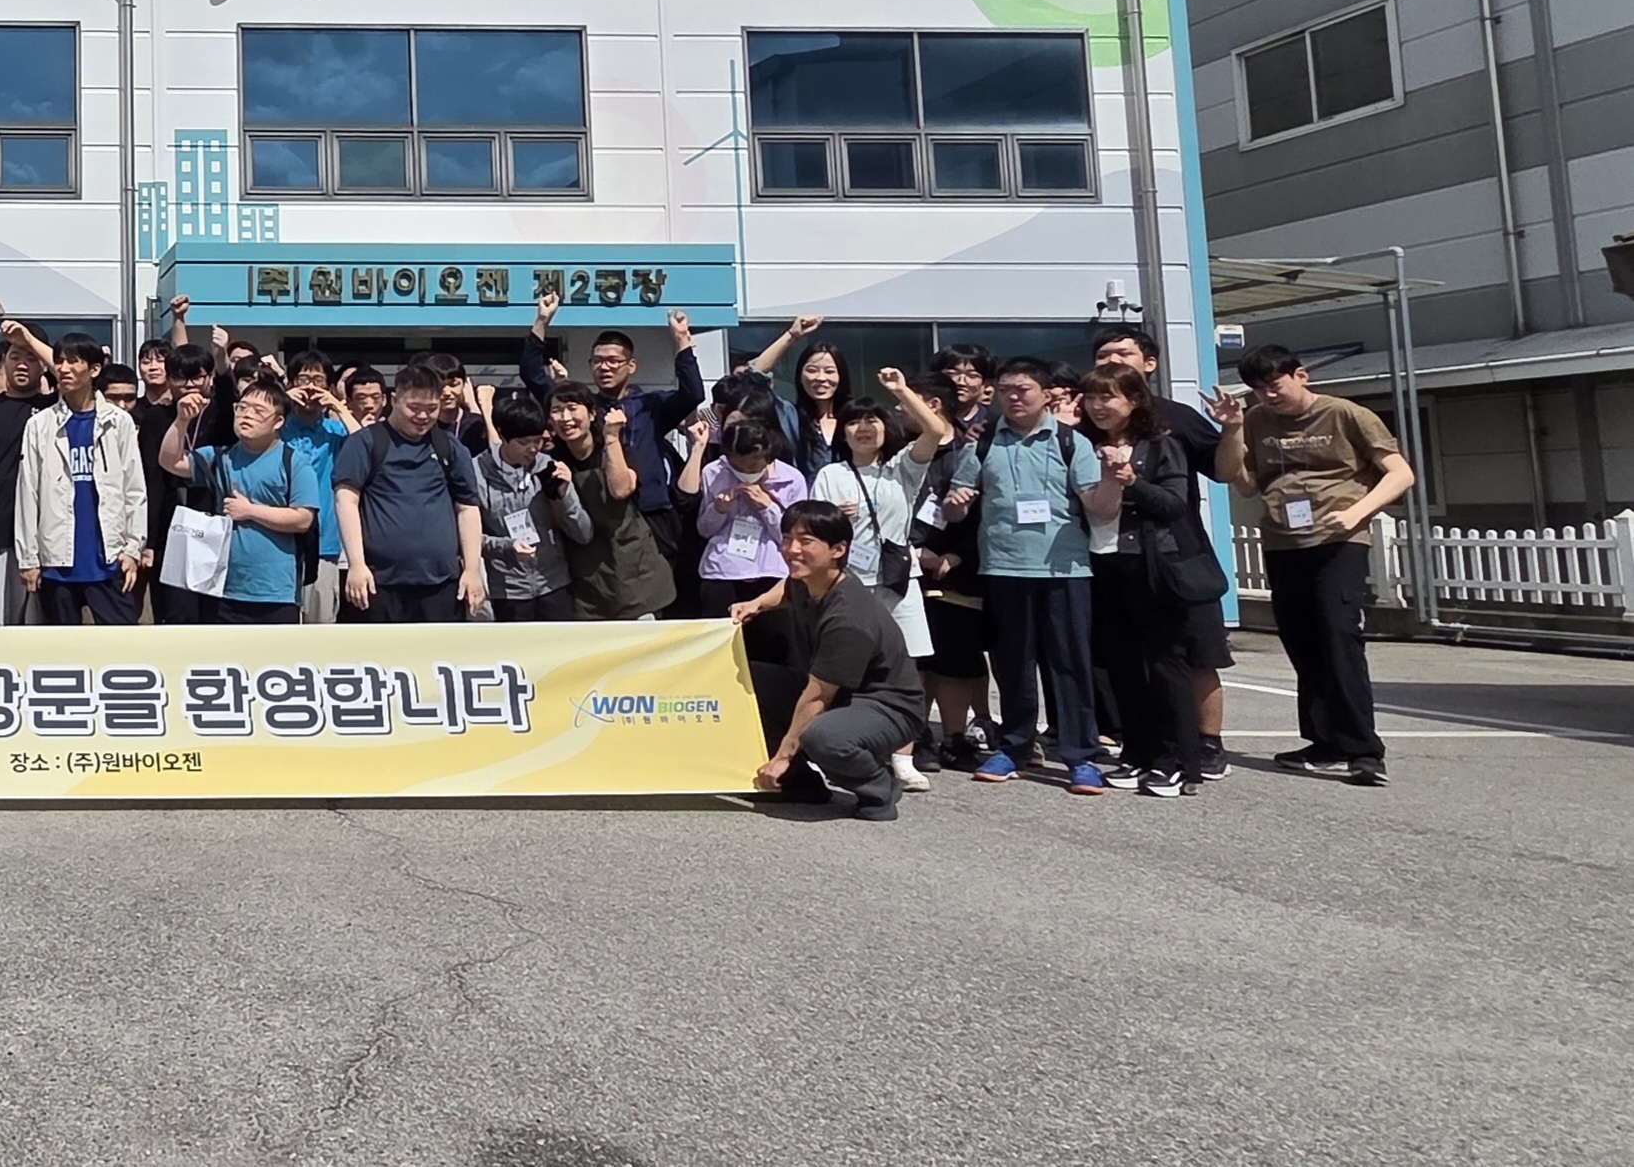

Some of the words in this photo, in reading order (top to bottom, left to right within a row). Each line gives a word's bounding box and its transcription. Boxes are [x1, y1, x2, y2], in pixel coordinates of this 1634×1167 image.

[533, 268, 668, 307] 제2공장
[183, 661, 535, 737] 환영합니다
[592, 695, 655, 715] WON
[658, 699, 719, 714] BIOGEN
[9, 752, 50, 772] 장소
[66, 751, 203, 774] (주)원바이오젠
